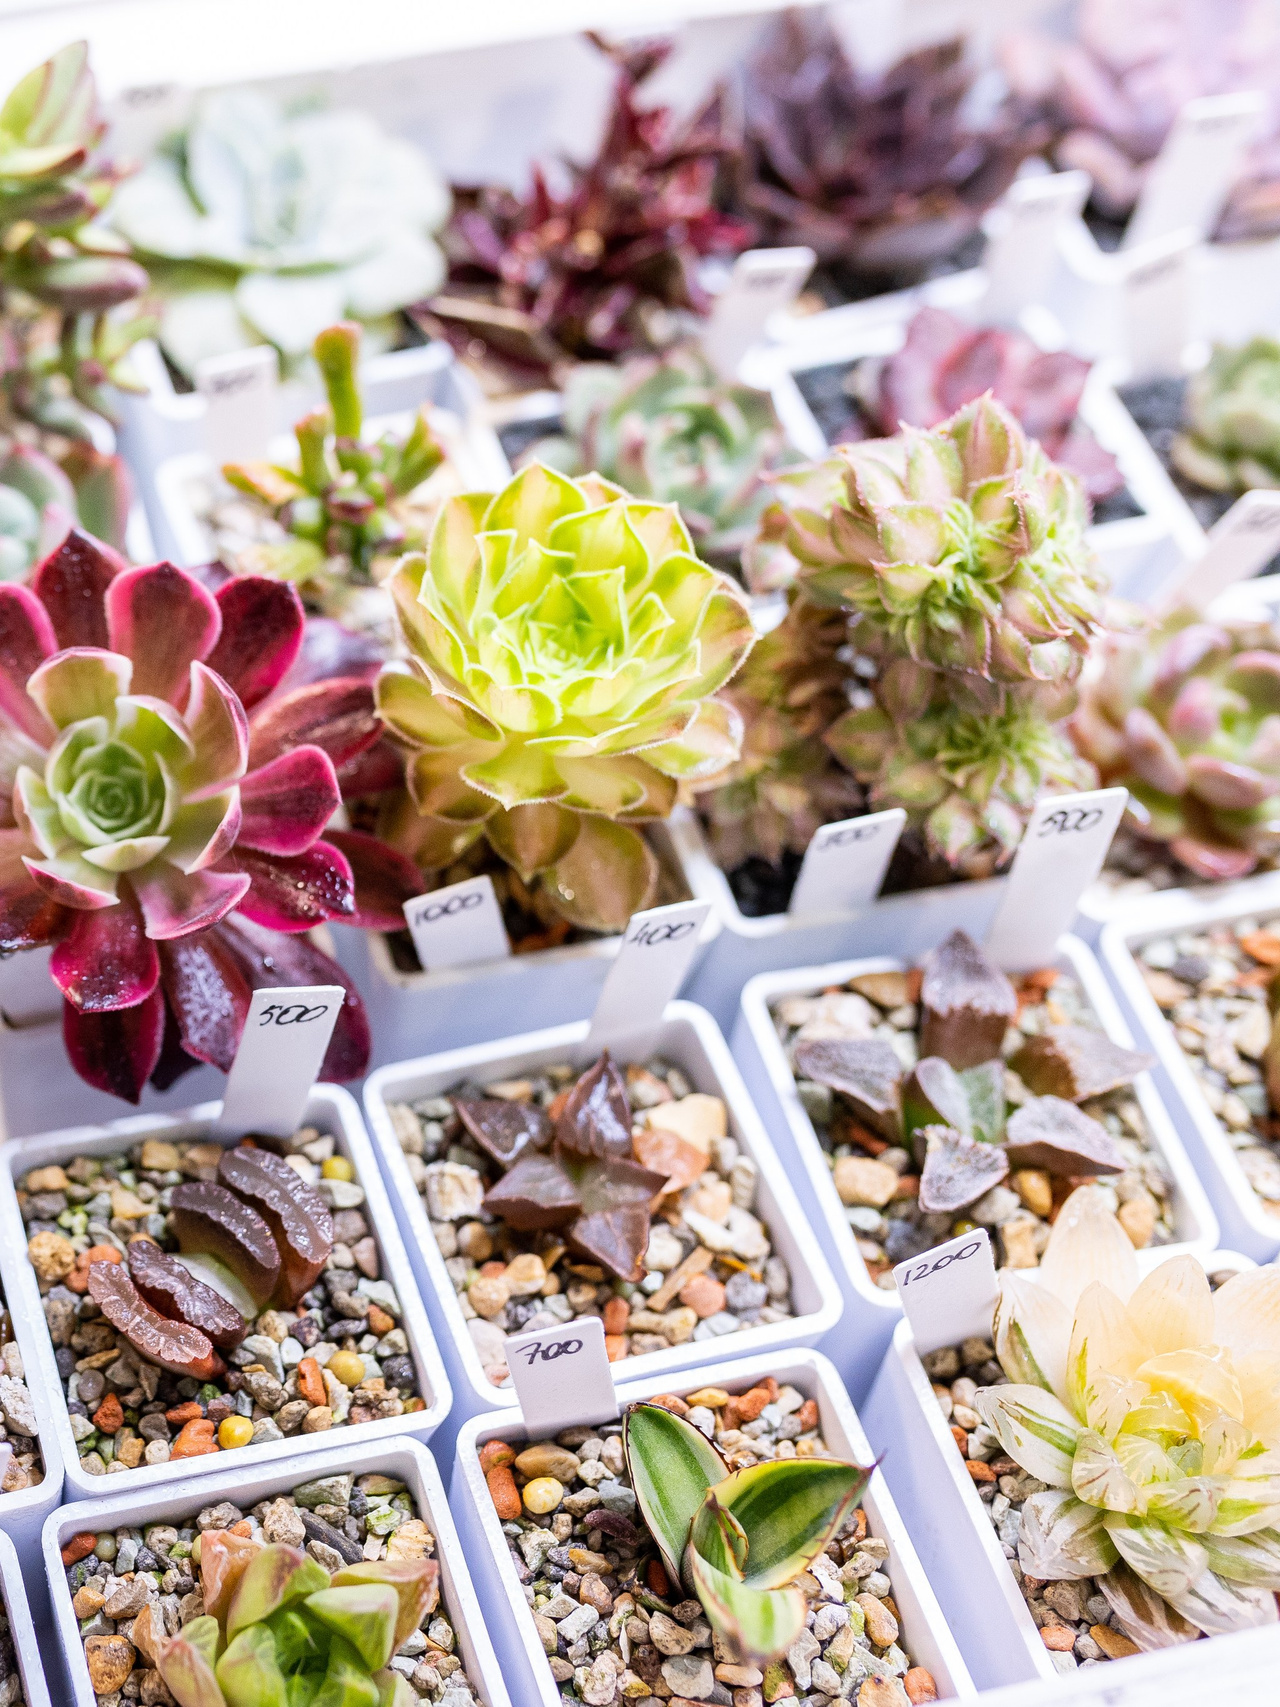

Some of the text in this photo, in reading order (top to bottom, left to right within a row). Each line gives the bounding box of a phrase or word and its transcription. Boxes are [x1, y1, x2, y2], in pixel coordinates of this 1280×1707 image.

[1037, 808, 1103, 838] 500
[414, 892, 485, 927] 1000
[629, 921, 695, 946] 400
[259, 1004, 329, 1026] 500
[902, 1242, 981, 1286] 1200
[515, 1339, 584, 1365] 700
